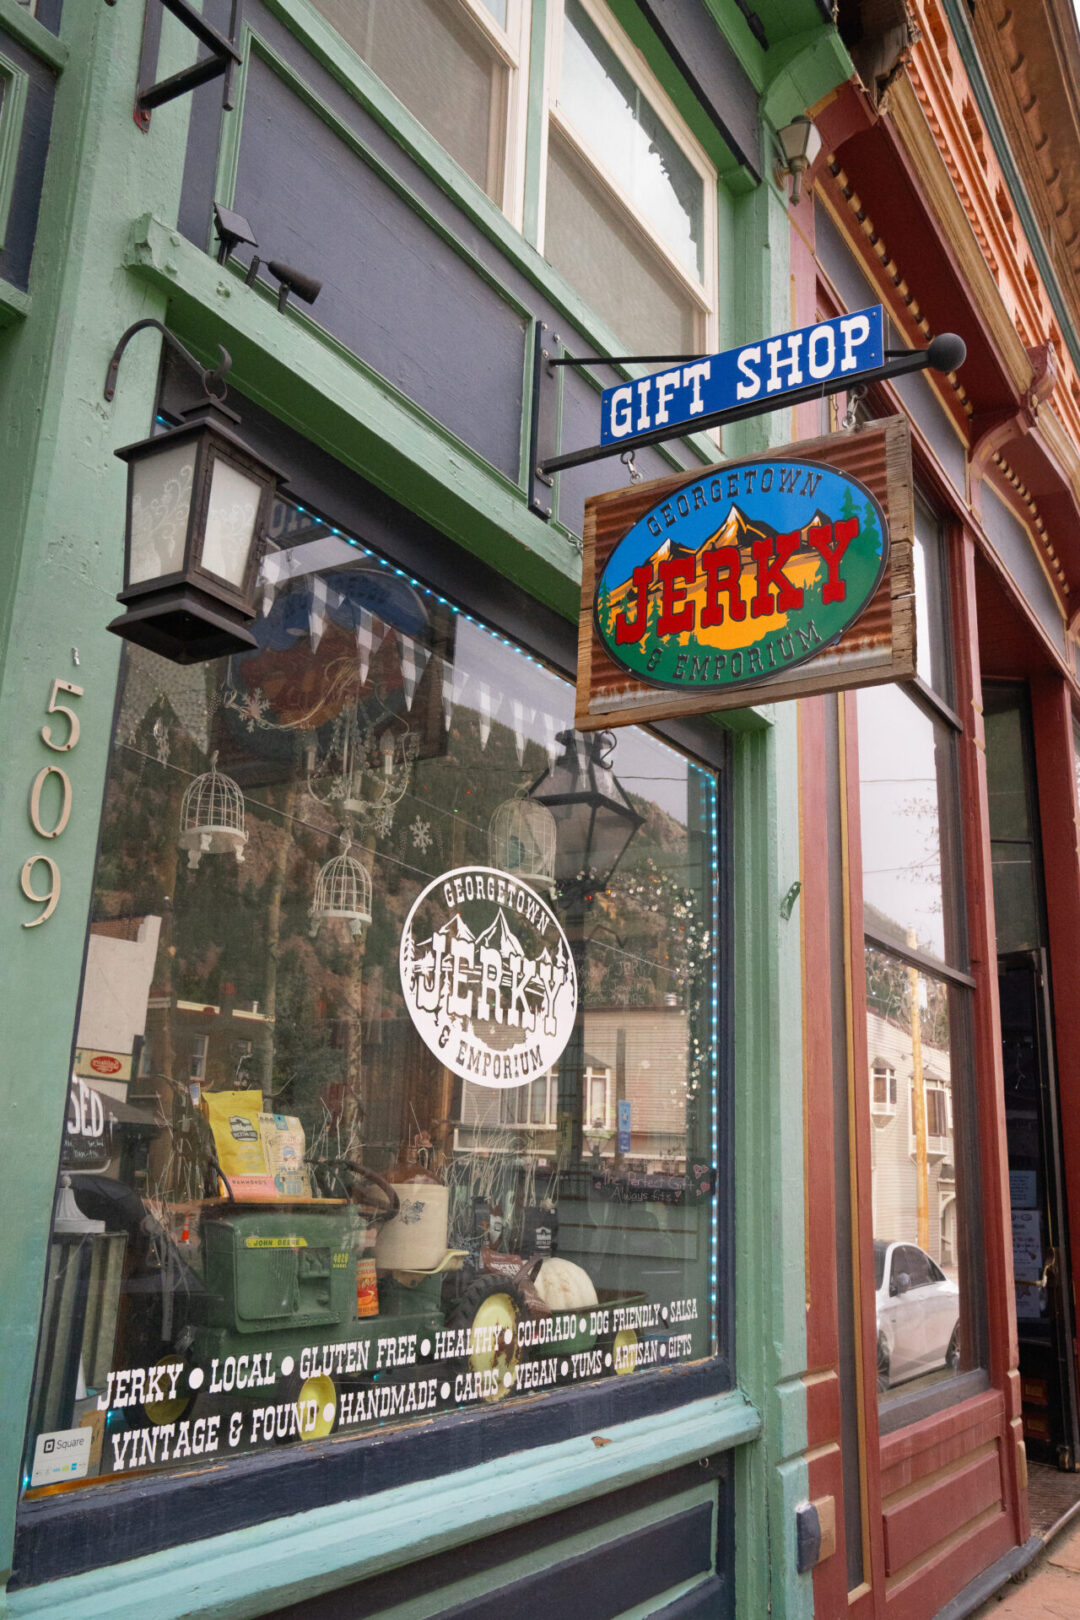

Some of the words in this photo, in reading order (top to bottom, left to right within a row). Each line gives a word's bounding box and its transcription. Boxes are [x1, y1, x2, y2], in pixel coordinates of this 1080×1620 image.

[609, 360, 711, 438] GIFT
[736, 314, 870, 401] SHOP
[646, 467, 823, 537] GEORGETOWN
[615, 516, 860, 646] JERKY
[646, 647, 662, 672] &
[672, 619, 823, 682] EMPORIUM
[443, 875, 551, 936] GEORGETOWN
[415, 931, 567, 1037] JERKY
[438, 1024, 450, 1049] &
[456, 1040, 544, 1080] EMPORIUM
[610, 1186, 648, 1203] Always
[97, 1363, 184, 1412] JERKY
[209, 1352, 276, 1394] LOCAL
[299, 1339, 371, 1380] GLUTEN
[376, 1334, 417, 1369] FREE
[433, 1325, 503, 1360] HEALTHY
[517, 1313, 577, 1347] COLORADO
[589, 1310, 609, 1336] DOG
[612, 1303, 661, 1332] FRIENDLY
[669, 1298, 698, 1323] SALSA
[111, 1415, 221, 1471] VINTAGE
[228, 1411, 243, 1447] &
[250, 1400, 317, 1444] FOUND
[338, 1378, 437, 1426] HANDMADE
[454, 1368, 499, 1402] CARDS
[515, 1358, 558, 1391] VEGAN
[571, 1350, 603, 1379] YUMS
[614, 1339, 658, 1371] ARTISAN
[667, 1333, 692, 1358] GIFTS
[56, 1437, 85, 1452] Square
